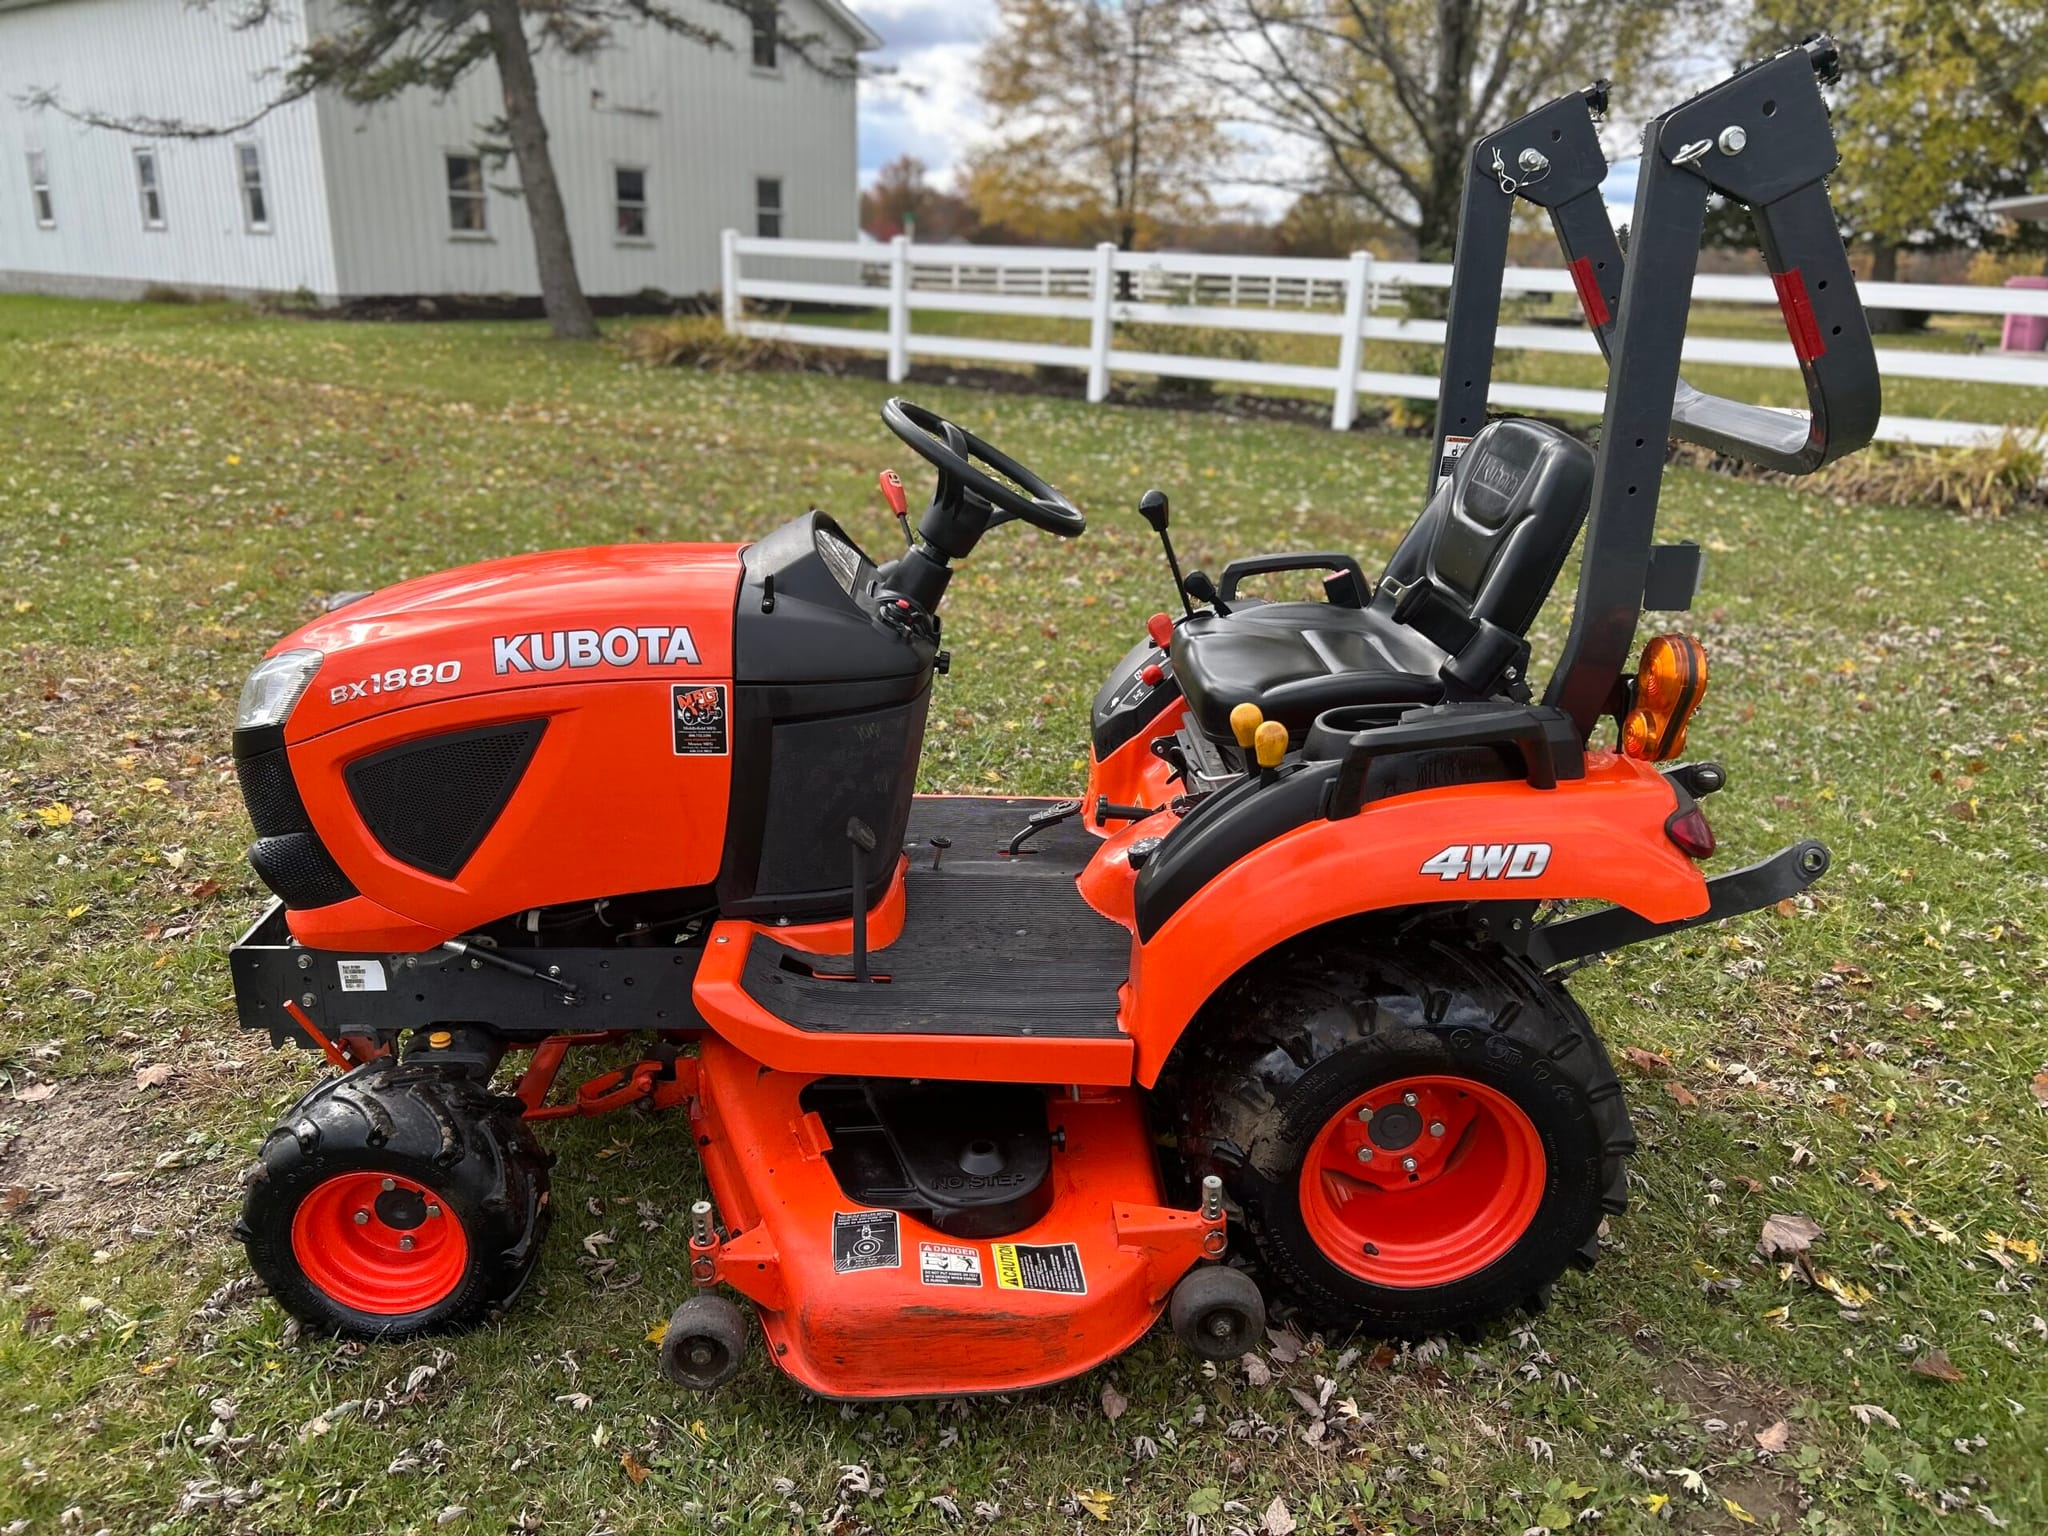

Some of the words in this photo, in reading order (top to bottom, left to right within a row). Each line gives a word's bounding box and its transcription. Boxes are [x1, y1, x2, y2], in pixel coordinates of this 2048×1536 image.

[492, 625, 702, 675] KUBOTA
[330, 660, 462, 705] BX1880
[1419, 843, 1553, 882] 4WD
[930, 1175, 964, 1190] NO
[968, 1172, 1026, 1190] STEP
[933, 1245, 976, 1257] DANGER
[998, 1244, 1016, 1277] CAUTION
